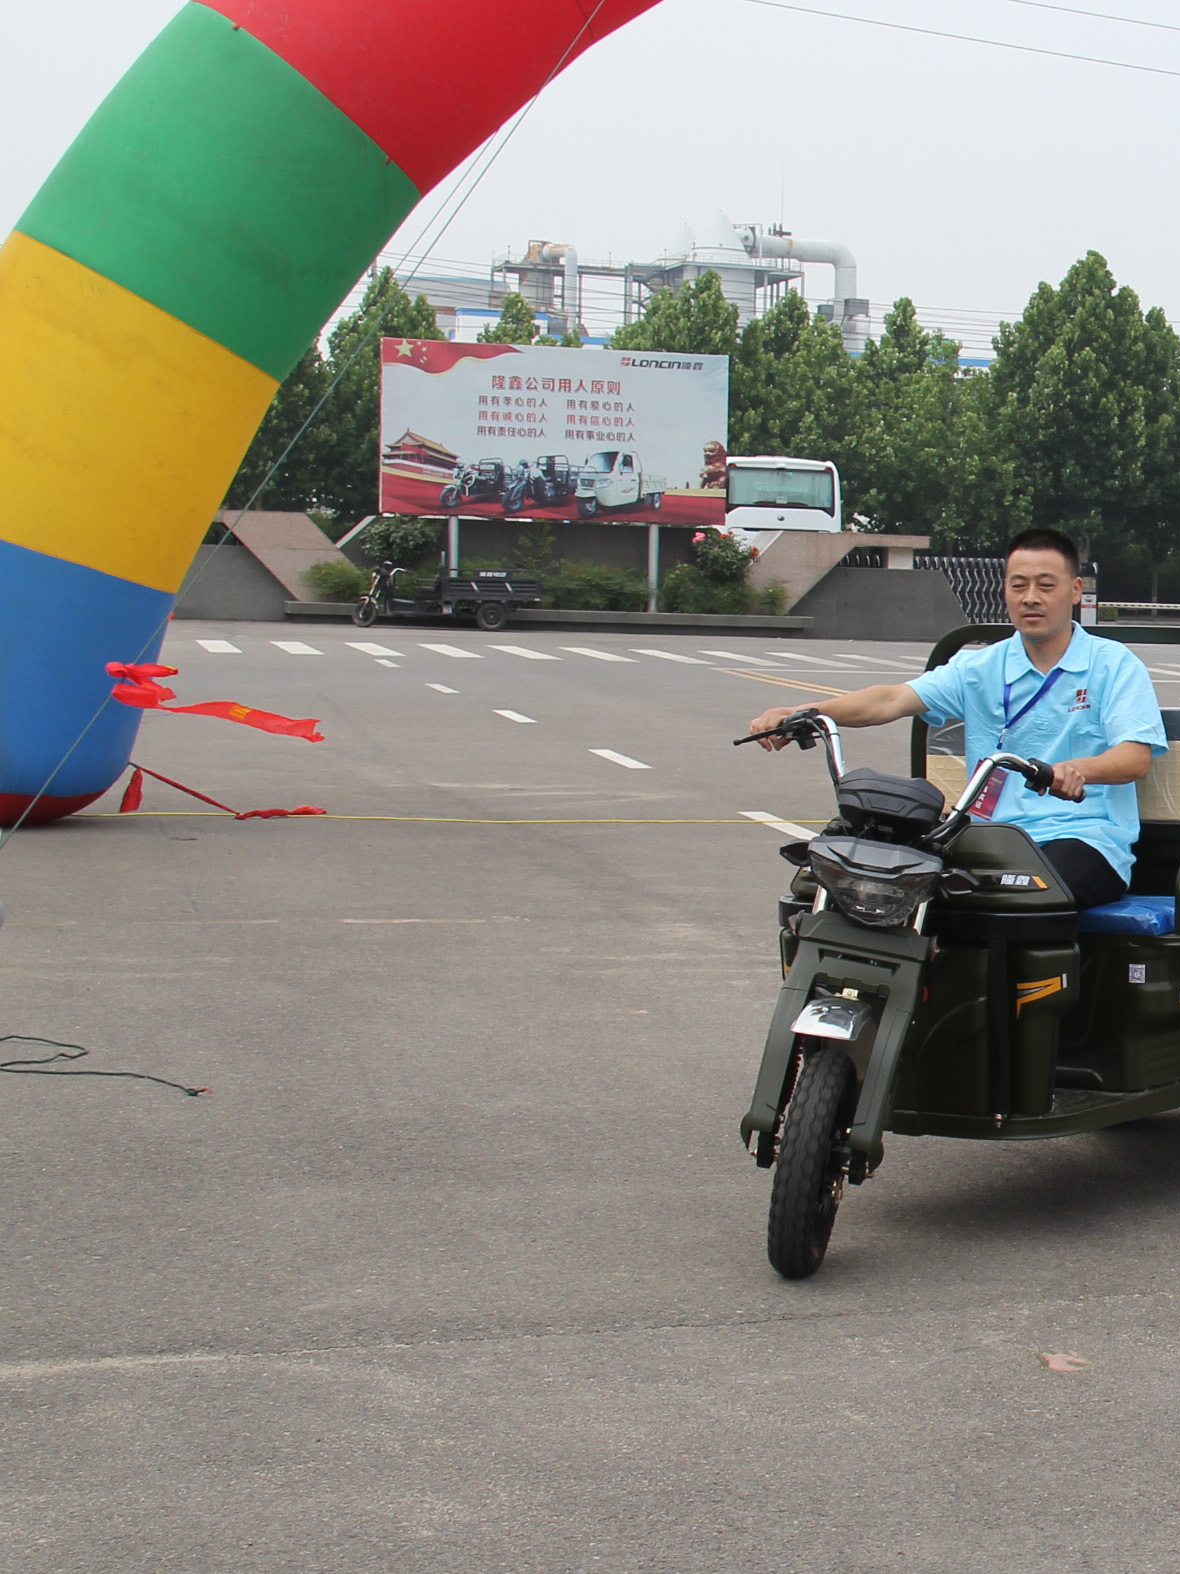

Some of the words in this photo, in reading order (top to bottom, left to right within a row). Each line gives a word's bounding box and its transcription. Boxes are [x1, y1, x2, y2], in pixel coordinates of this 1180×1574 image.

[491, 375, 622, 396] 隆鑫公司用人原则
[478, 395, 549, 408] 用有孝心的人
[566, 399, 636, 412] 用有爱心的人
[478, 410, 549, 423] 用有诚心的人
[566, 414, 636, 427] 用有信心的人
[476, 425, 548, 438] 用有责任心的人
[564, 429, 637, 443] 用有事业心的人
